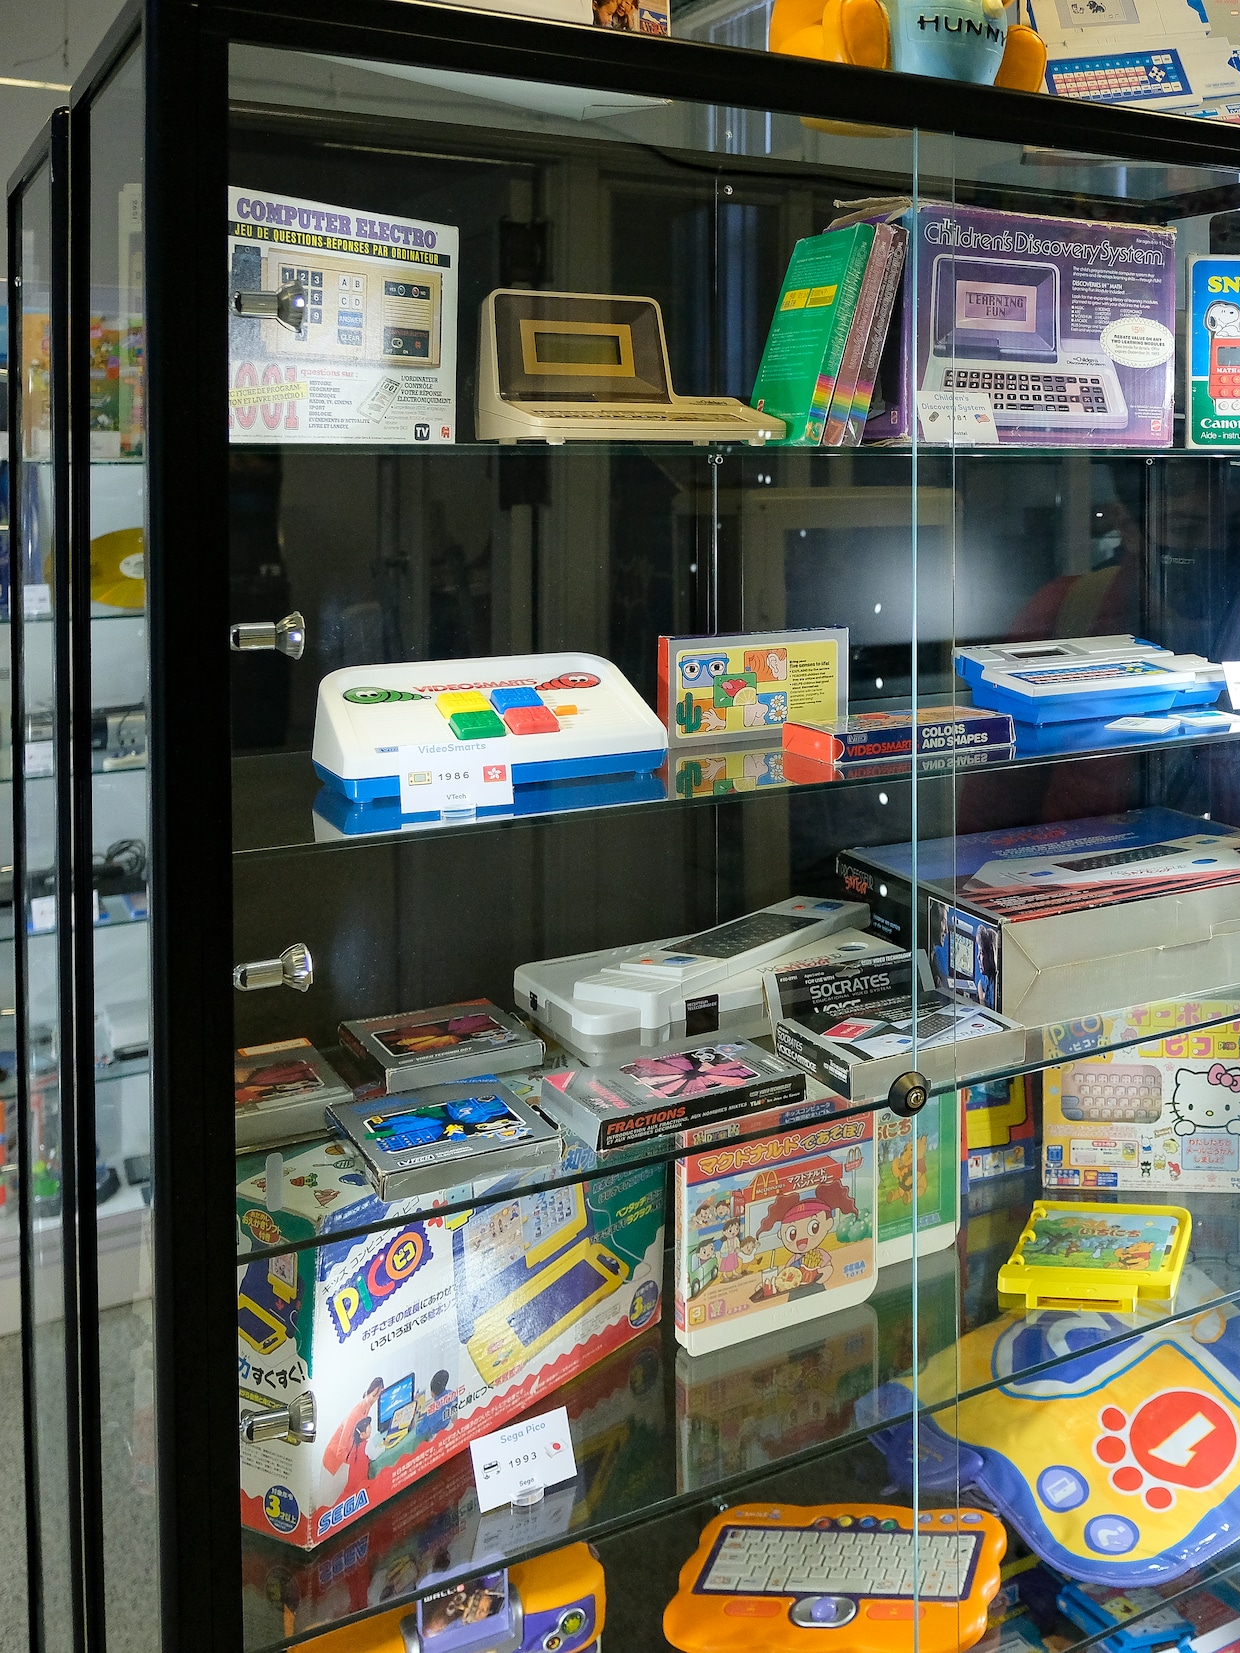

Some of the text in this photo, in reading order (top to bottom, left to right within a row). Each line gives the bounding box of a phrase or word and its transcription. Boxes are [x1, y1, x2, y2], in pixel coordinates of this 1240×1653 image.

[917, 14, 1007, 47] HUNNY
[237, 197, 437, 250] COMPUTER ELECTRO
[235, 223, 253, 238] JEU
[257, 226, 269, 240] DE
[373, 244, 389, 258] PAR
[391, 246, 439, 266] ORDINATEUR
[924, 221, 1163, 267] Children's Discovery System
[1072, 280, 1101, 288] DISCOVERIES
[968, 293, 1024, 309] LEARNING
[985, 306, 1006, 317] FUN
[339, 315, 363, 325] ANSWER
[340, 333, 360, 342] CLEAR
[301, 368, 340, 379] questions
[236, 388, 256, 397] FICHE
[404, 382, 433, 390] CONTRÔLE
[252, 394, 272, 404] LIVRE
[921, 403, 986, 413] Discovery System
[415, 426, 429, 438] TV
[413, 678, 538, 693] VIDEOSMARTS
[922, 724, 966, 738] COLORS
[418, 743, 487, 754] VideoSmarts
[846, 738, 919, 757] VIDEOSMART
[922, 732, 989, 750] AND SHAPES
[437, 771, 470, 781] 1986
[446, 793, 467, 801] VTech
[884, 952, 912, 963] TECHNOLOGY
[810, 972, 890, 1000] SOCRATES
[812, 993, 850, 1004] EDUCATIONAL
[869, 985, 892, 995] SYSTEM
[777, 1030, 804, 1052] SOCRATES
[1164, 1034, 1211, 1056] ピコ
[606, 1102, 747, 1140] INTRODUCTION AUX FRACTIONS, AUX NOMBRES MIXTES
[607, 1106, 686, 1135] FRACTIONS
[627, 1130, 651, 1141] NOMBRES
[1189, 1139, 1233, 1147] わたしたちと
[787, 1168, 826, 1183] マクドナルド
[792, 1174, 835, 1190] ハンバーガー
[755, 1182, 786, 1195] McDonald's
[393, 1241, 417, 1270] ピコ
[843, 1260, 866, 1274] SEGA
[846, 1269, 864, 1279] TOYS
[321, 1268, 349, 1296] キッズ
[333, 1230, 424, 1335] PICO
[500, 1422, 546, 1444] Sega Pico
[508, 1451, 538, 1469] 1993
[519, 1477, 535, 1487] Sega
[317, 1488, 370, 1537] SEGA
